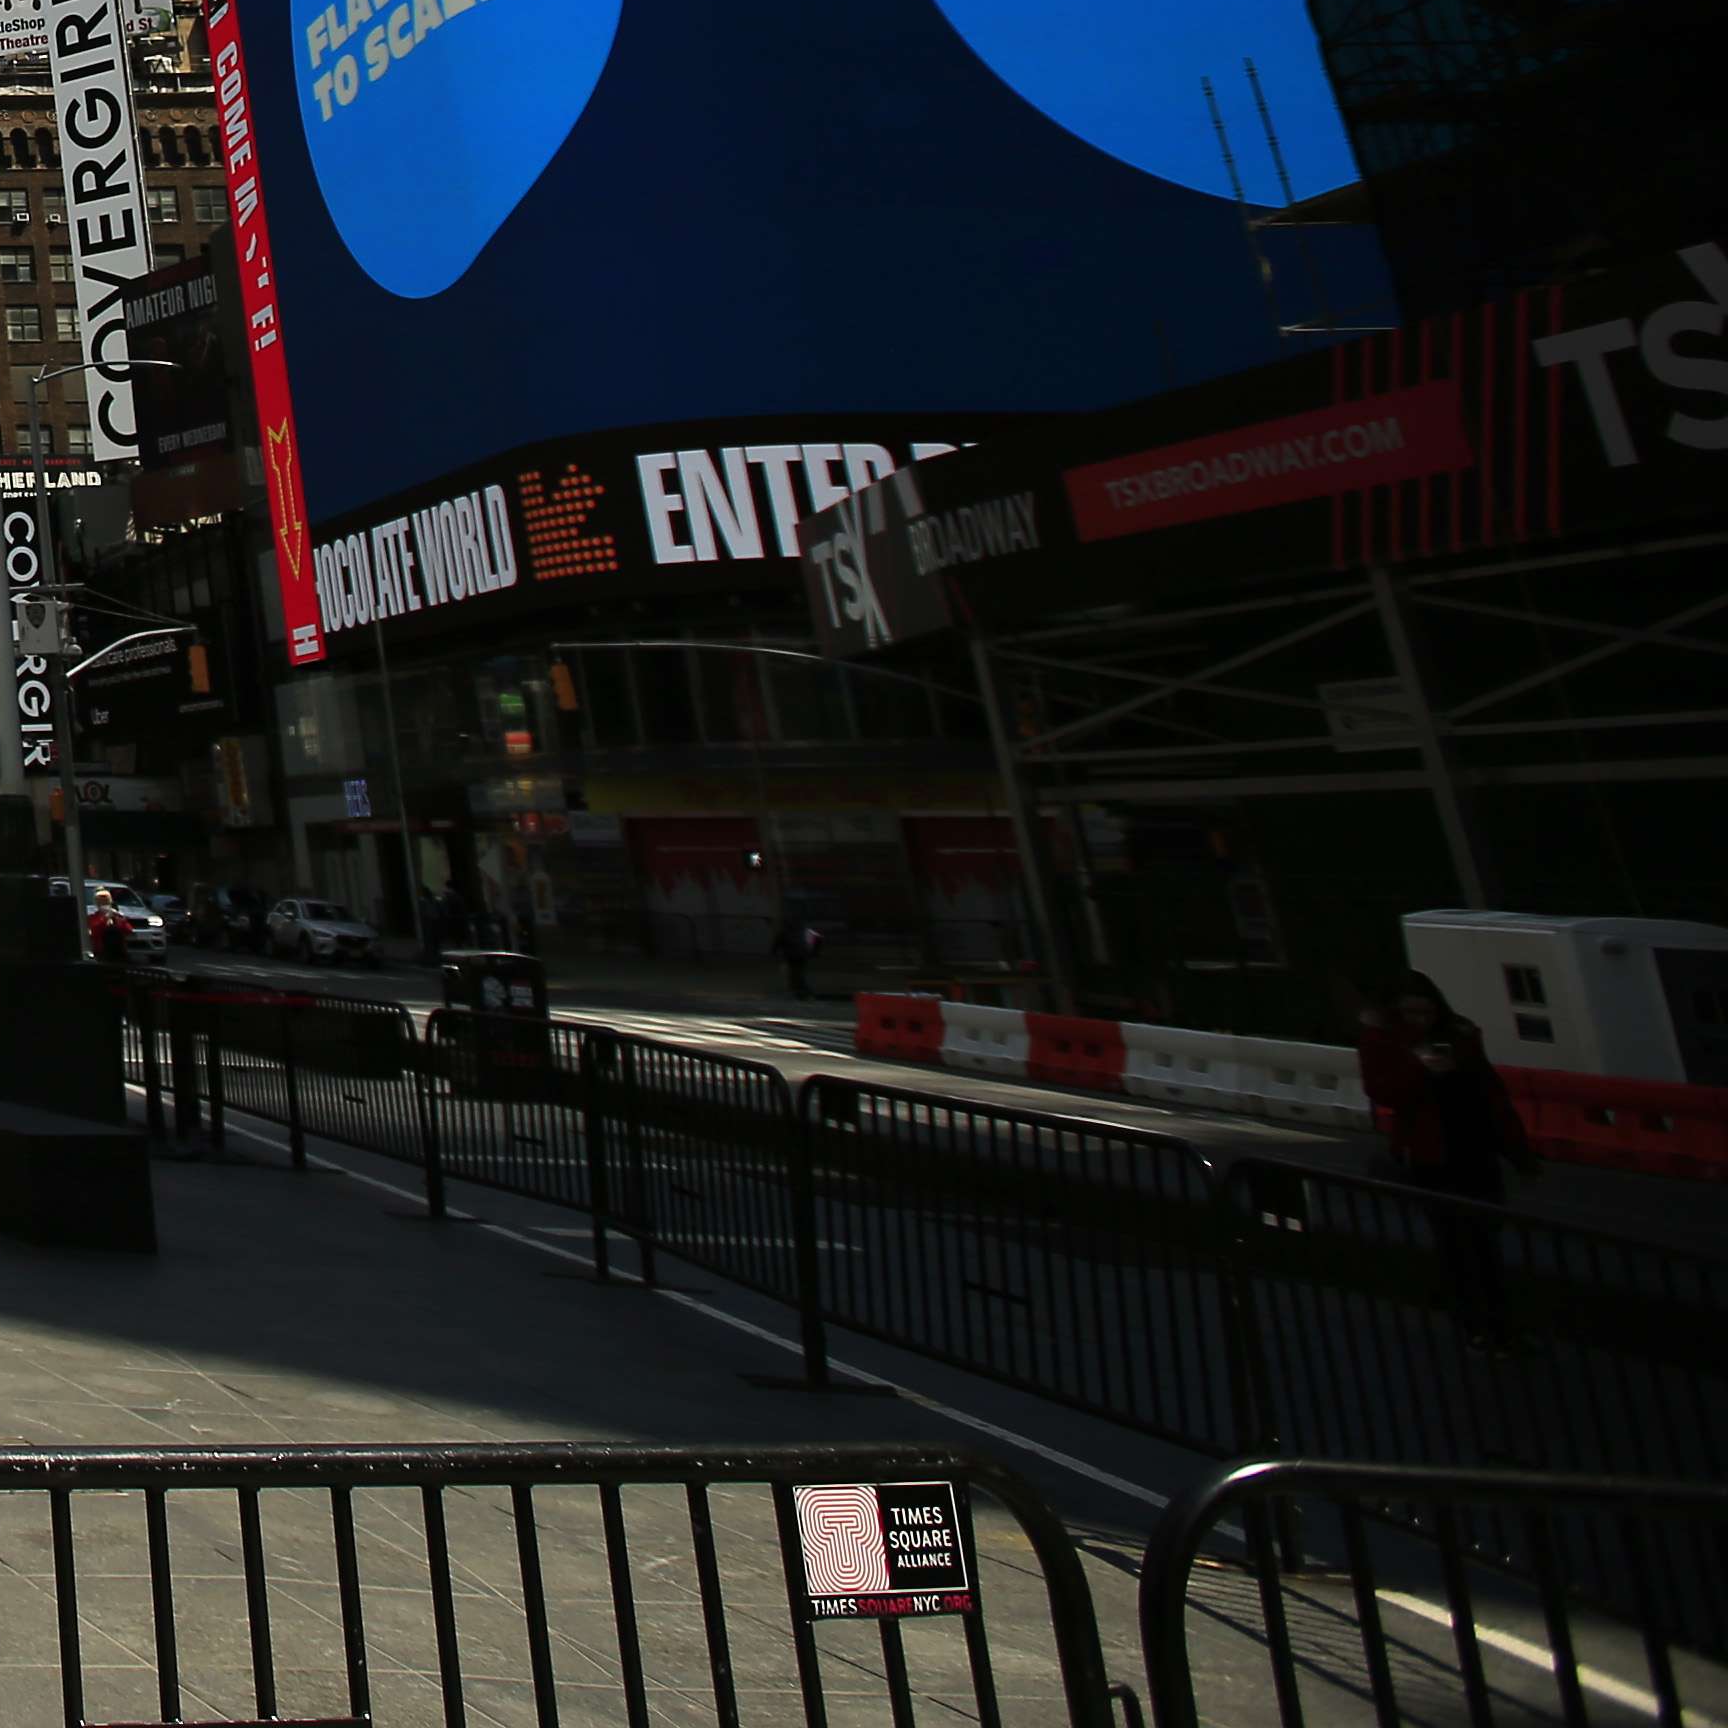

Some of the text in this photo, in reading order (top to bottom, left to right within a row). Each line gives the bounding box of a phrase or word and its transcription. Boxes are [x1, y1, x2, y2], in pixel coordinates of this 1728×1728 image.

[138, 17, 153, 30] St
[216, 40, 256, 174] COME
[312, 57, 360, 123] TO
[126, 284, 185, 329] AMATEUR
[1103, 417, 1405, 512] TSXBROADWAY.COM
[412, 483, 518, 608] WORLD
[908, 491, 1041, 577] BROADWAY
[889, 1529, 952, 1552] SQUARE
[890, 1506, 943, 1525] TIMES
[897, 1553, 952, 1568] ALLIANCE
